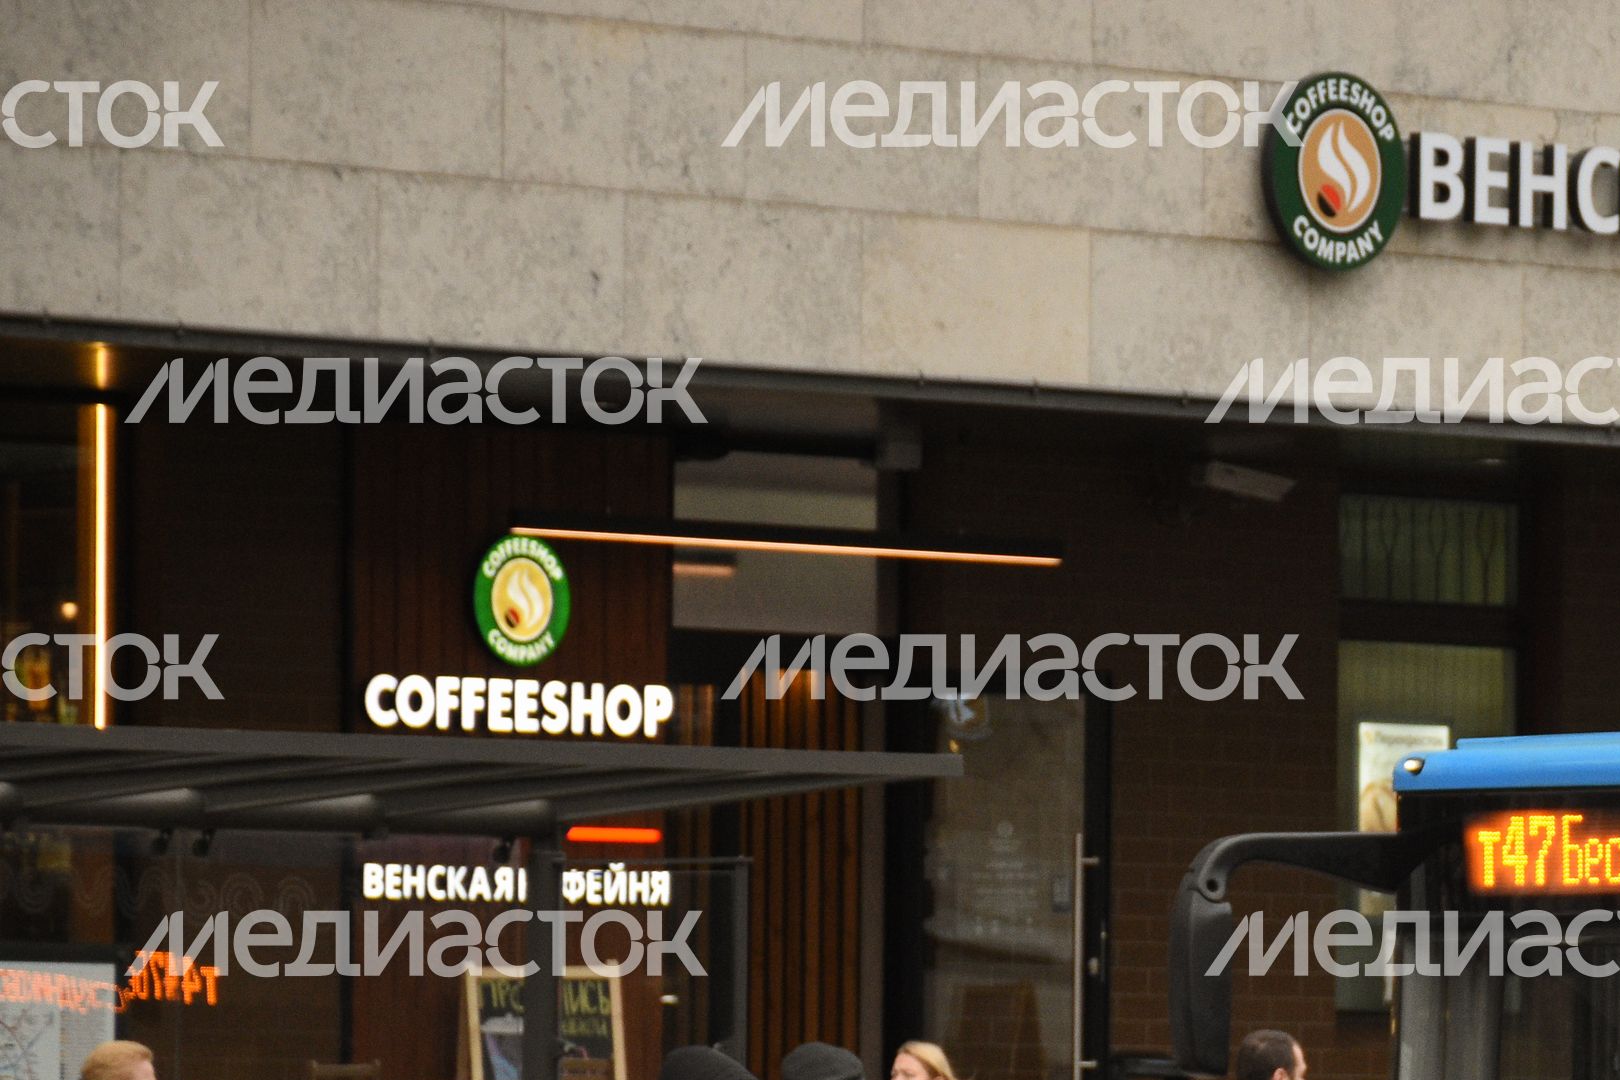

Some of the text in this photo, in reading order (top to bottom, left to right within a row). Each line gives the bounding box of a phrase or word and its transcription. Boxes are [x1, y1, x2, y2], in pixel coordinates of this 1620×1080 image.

[1286, 78, 1395, 141] COFFEESHOP
[1293, 215, 1383, 263] COMPANY
[365, 674, 675, 739] COFFEESHOP
[362, 862, 516, 901] ВЕНСКАЯ
